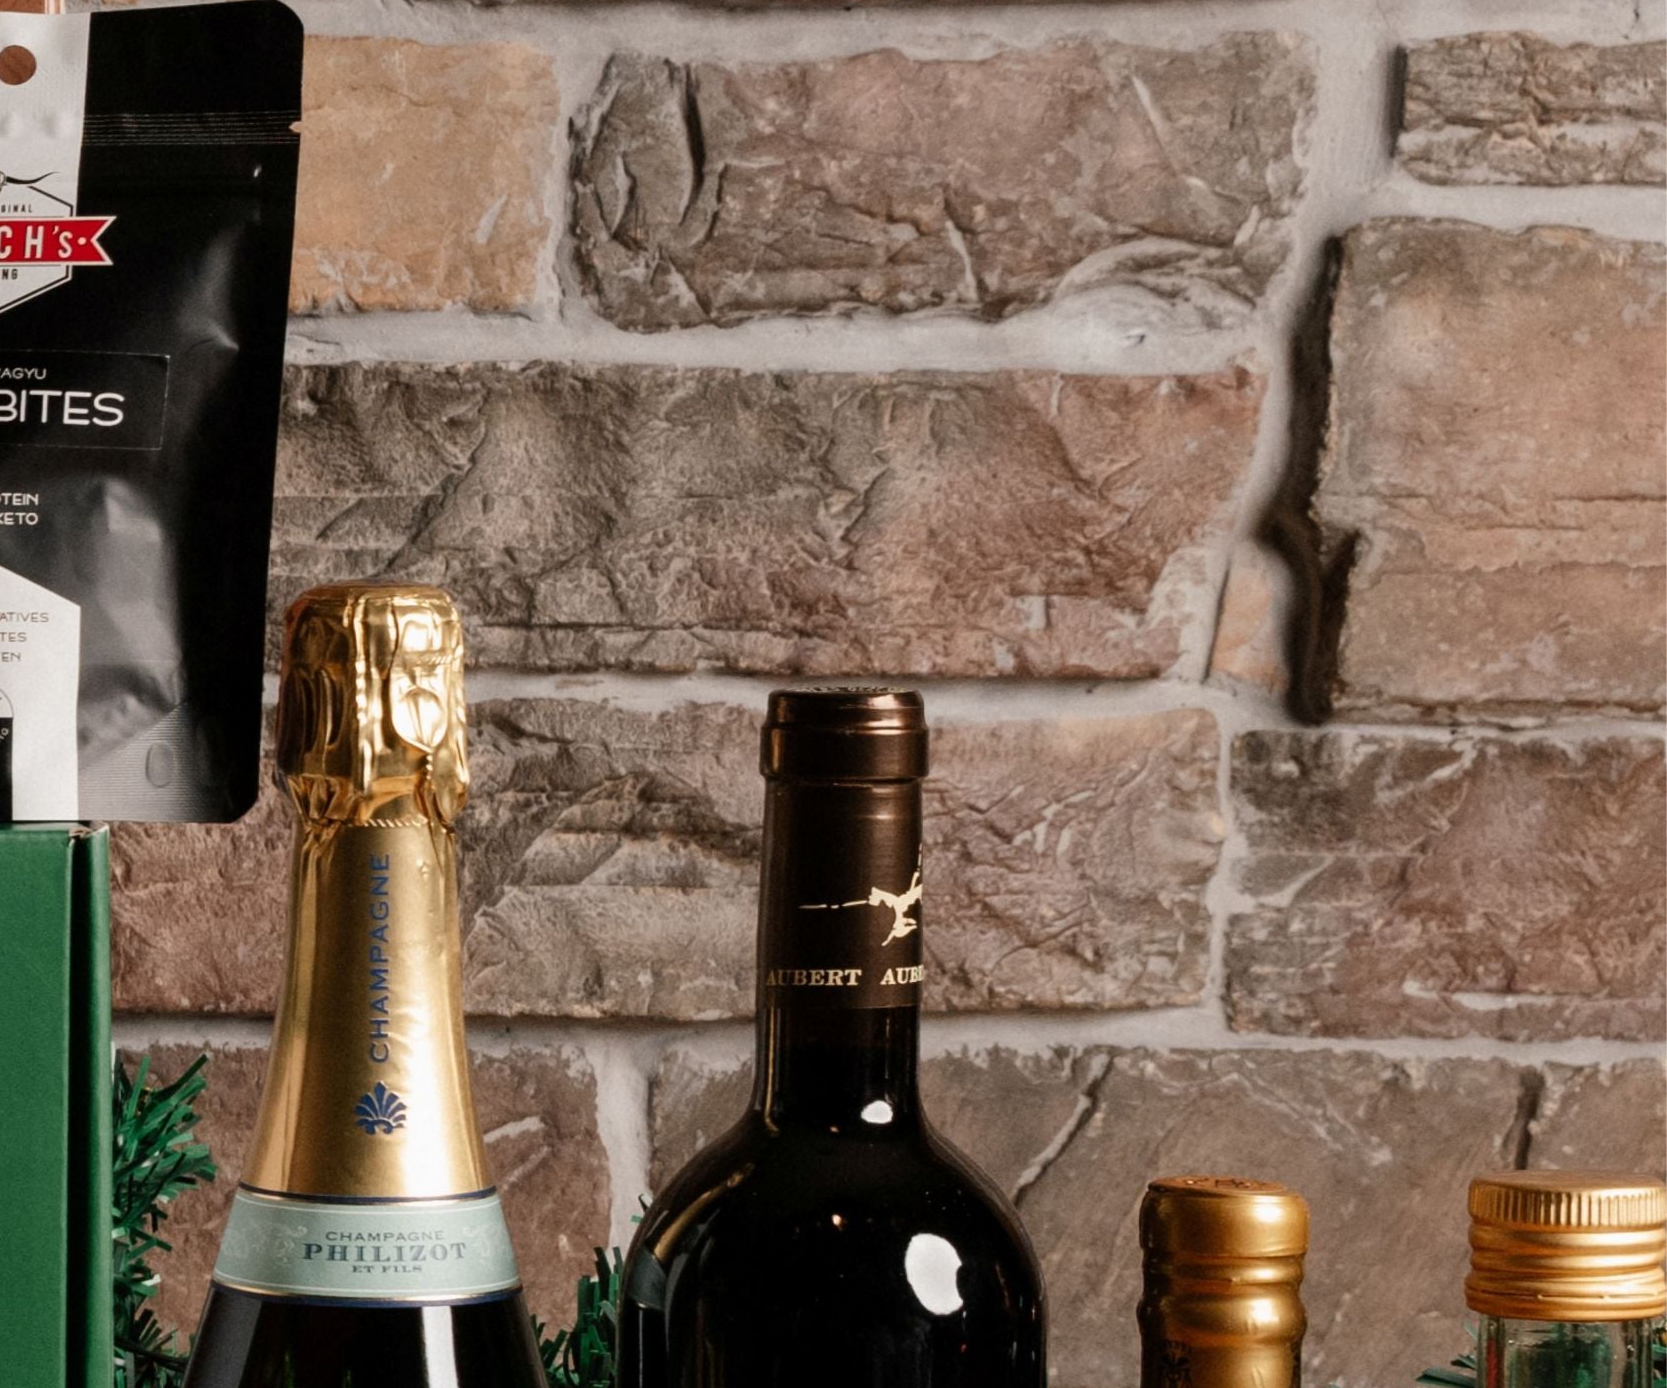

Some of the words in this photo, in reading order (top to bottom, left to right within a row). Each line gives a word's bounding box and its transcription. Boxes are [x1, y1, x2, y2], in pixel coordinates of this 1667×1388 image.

[367, 851, 393, 1065] CHAMPAGNE
[325, 1228, 445, 1243] CHAMPAGNE
[302, 1241, 466, 1264] PHILIZOT
